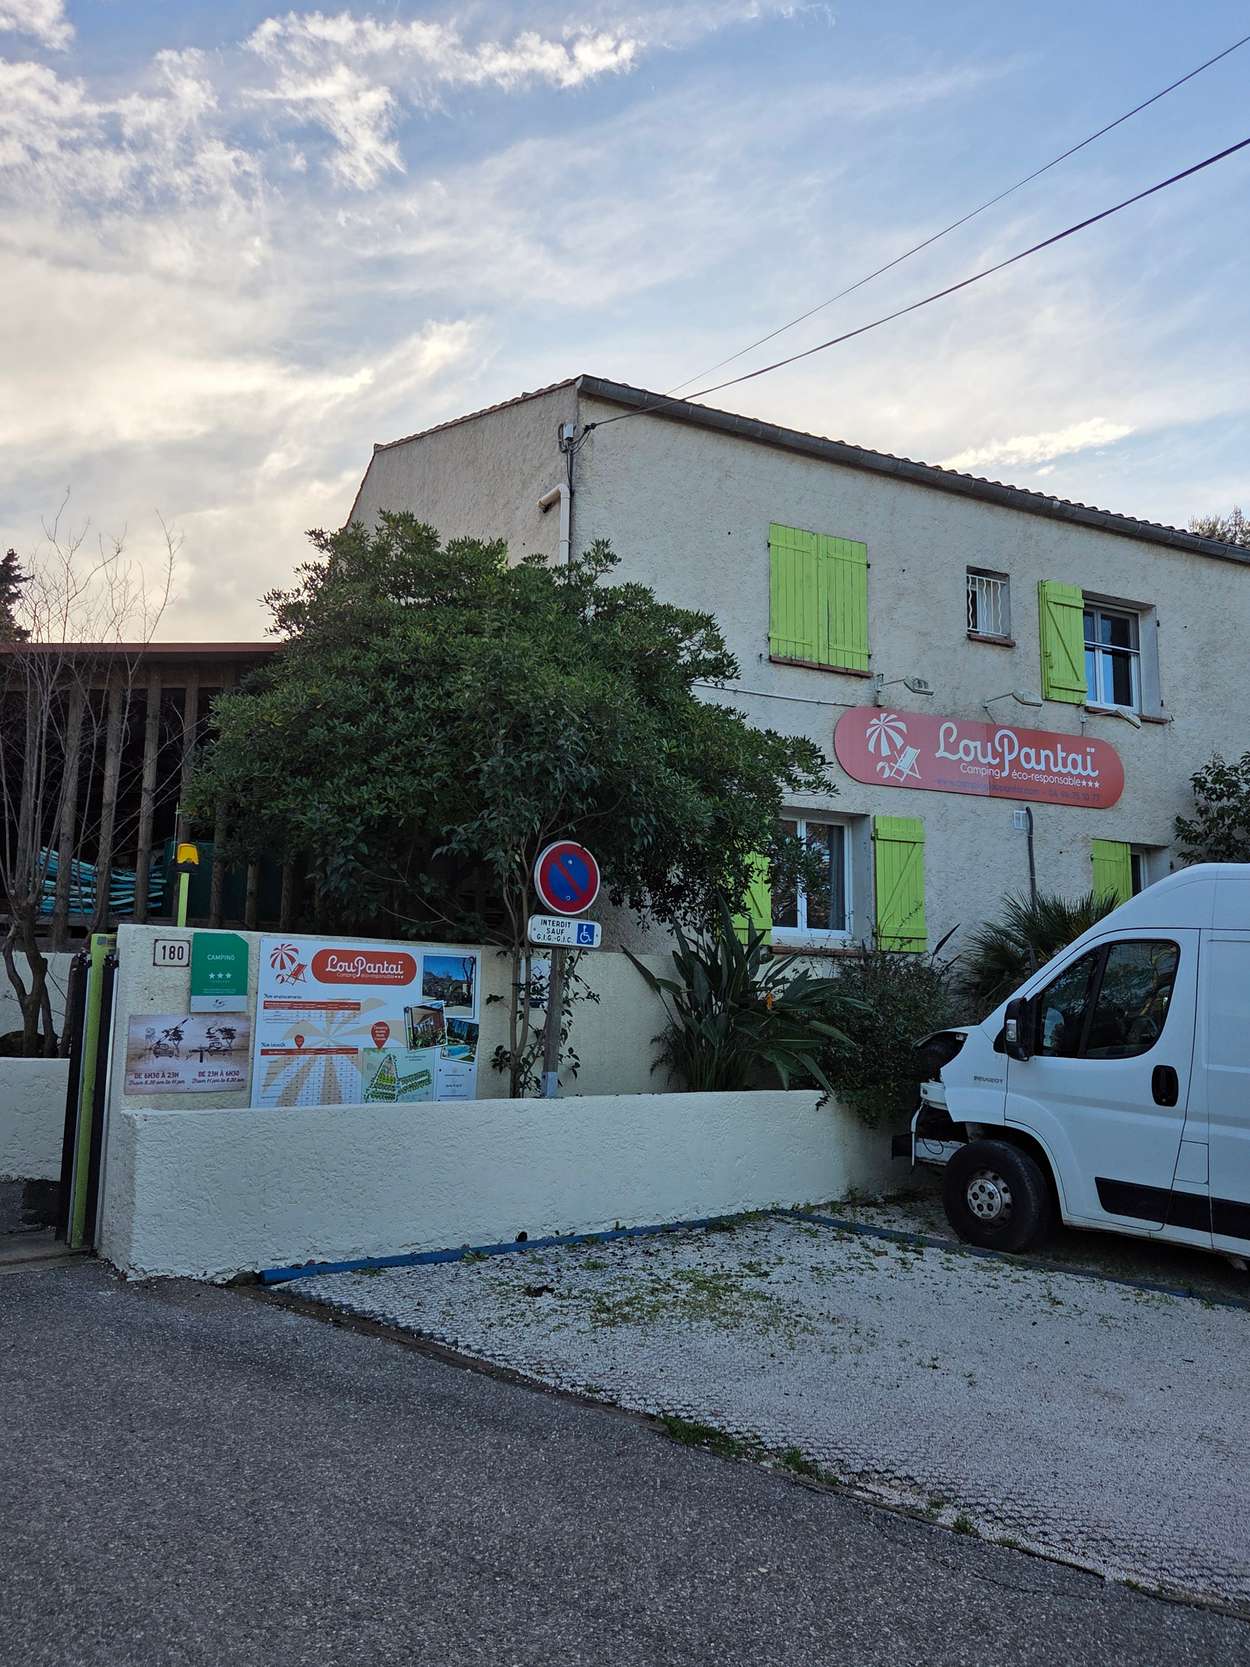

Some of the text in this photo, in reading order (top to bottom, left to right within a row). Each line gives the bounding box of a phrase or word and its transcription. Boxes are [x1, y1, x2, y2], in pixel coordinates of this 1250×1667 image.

[960, 763, 1000, 779] Camping
[1011, 769, 1081, 788] éco-responsable
[540, 919, 571, 928] INTERDIT
[161, 945, 184, 961] 180
[207, 953, 235, 961] CAMPING
